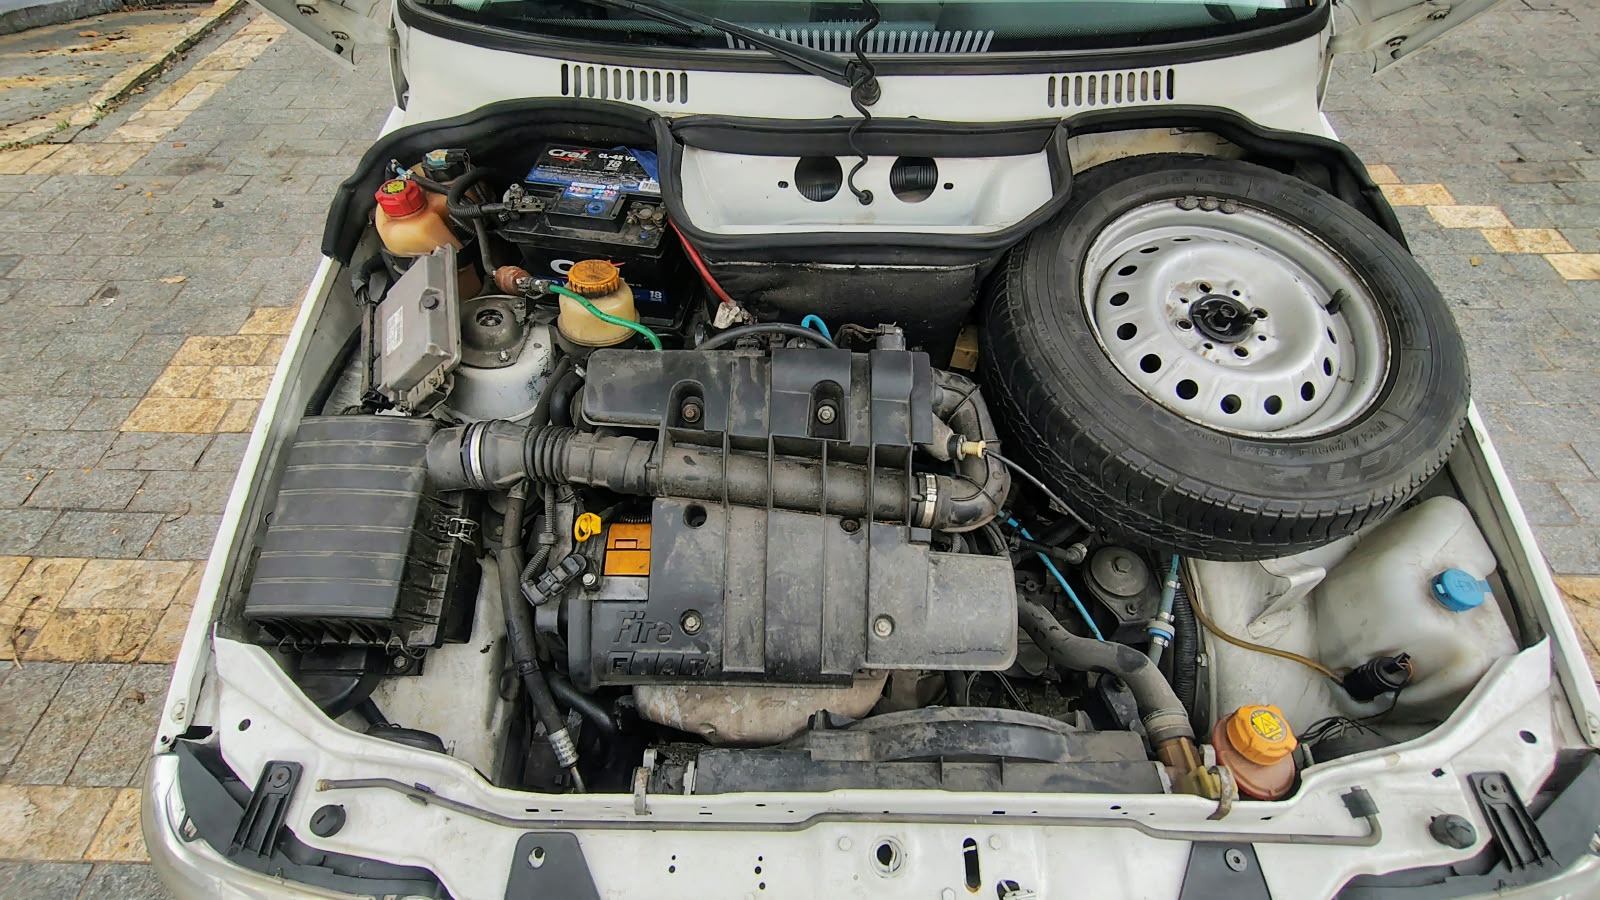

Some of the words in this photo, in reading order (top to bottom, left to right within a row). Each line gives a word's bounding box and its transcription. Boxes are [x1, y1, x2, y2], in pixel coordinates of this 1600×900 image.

[606, 160, 622, 168] 18
[649, 290, 663, 299] 18
[613, 610, 673, 645] Fire
[609, 653, 707, 676] FIAT
